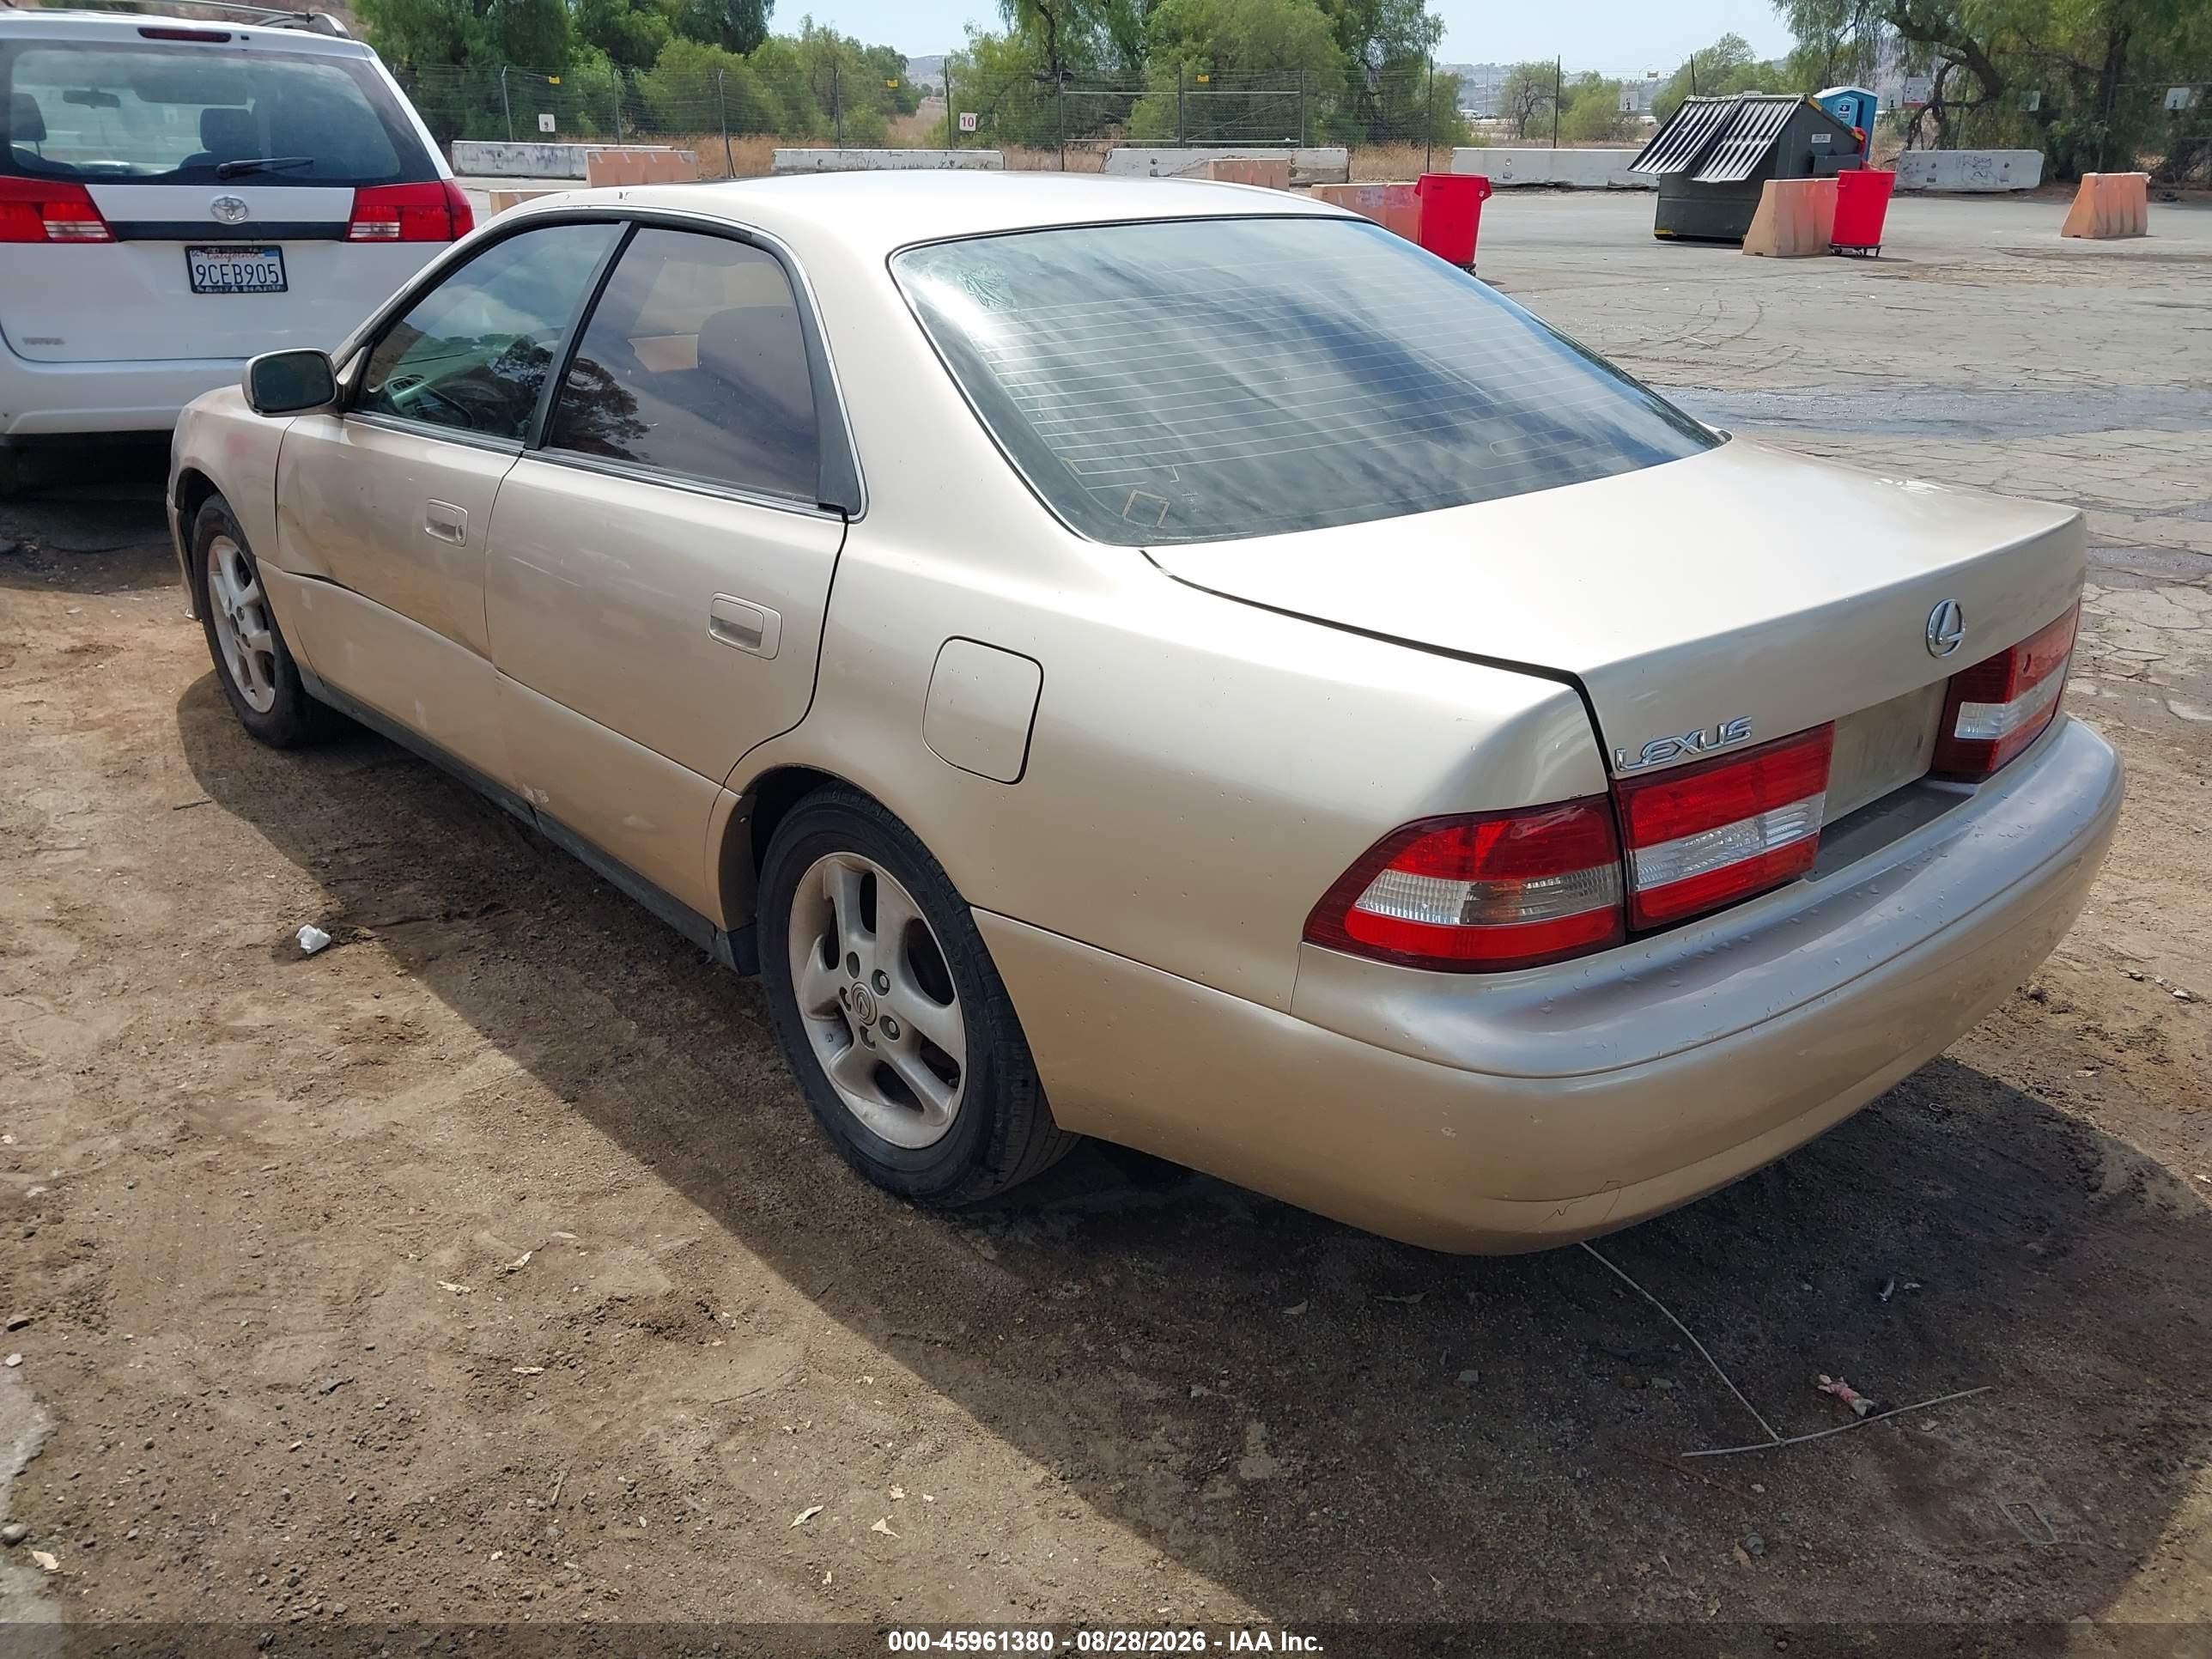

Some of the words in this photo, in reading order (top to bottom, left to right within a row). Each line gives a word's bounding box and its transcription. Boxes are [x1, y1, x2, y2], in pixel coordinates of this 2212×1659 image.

[962, 116, 974, 127] 10
[196, 264, 279, 285] 9CEB905
[1615, 715, 1752, 771] LEXUS
